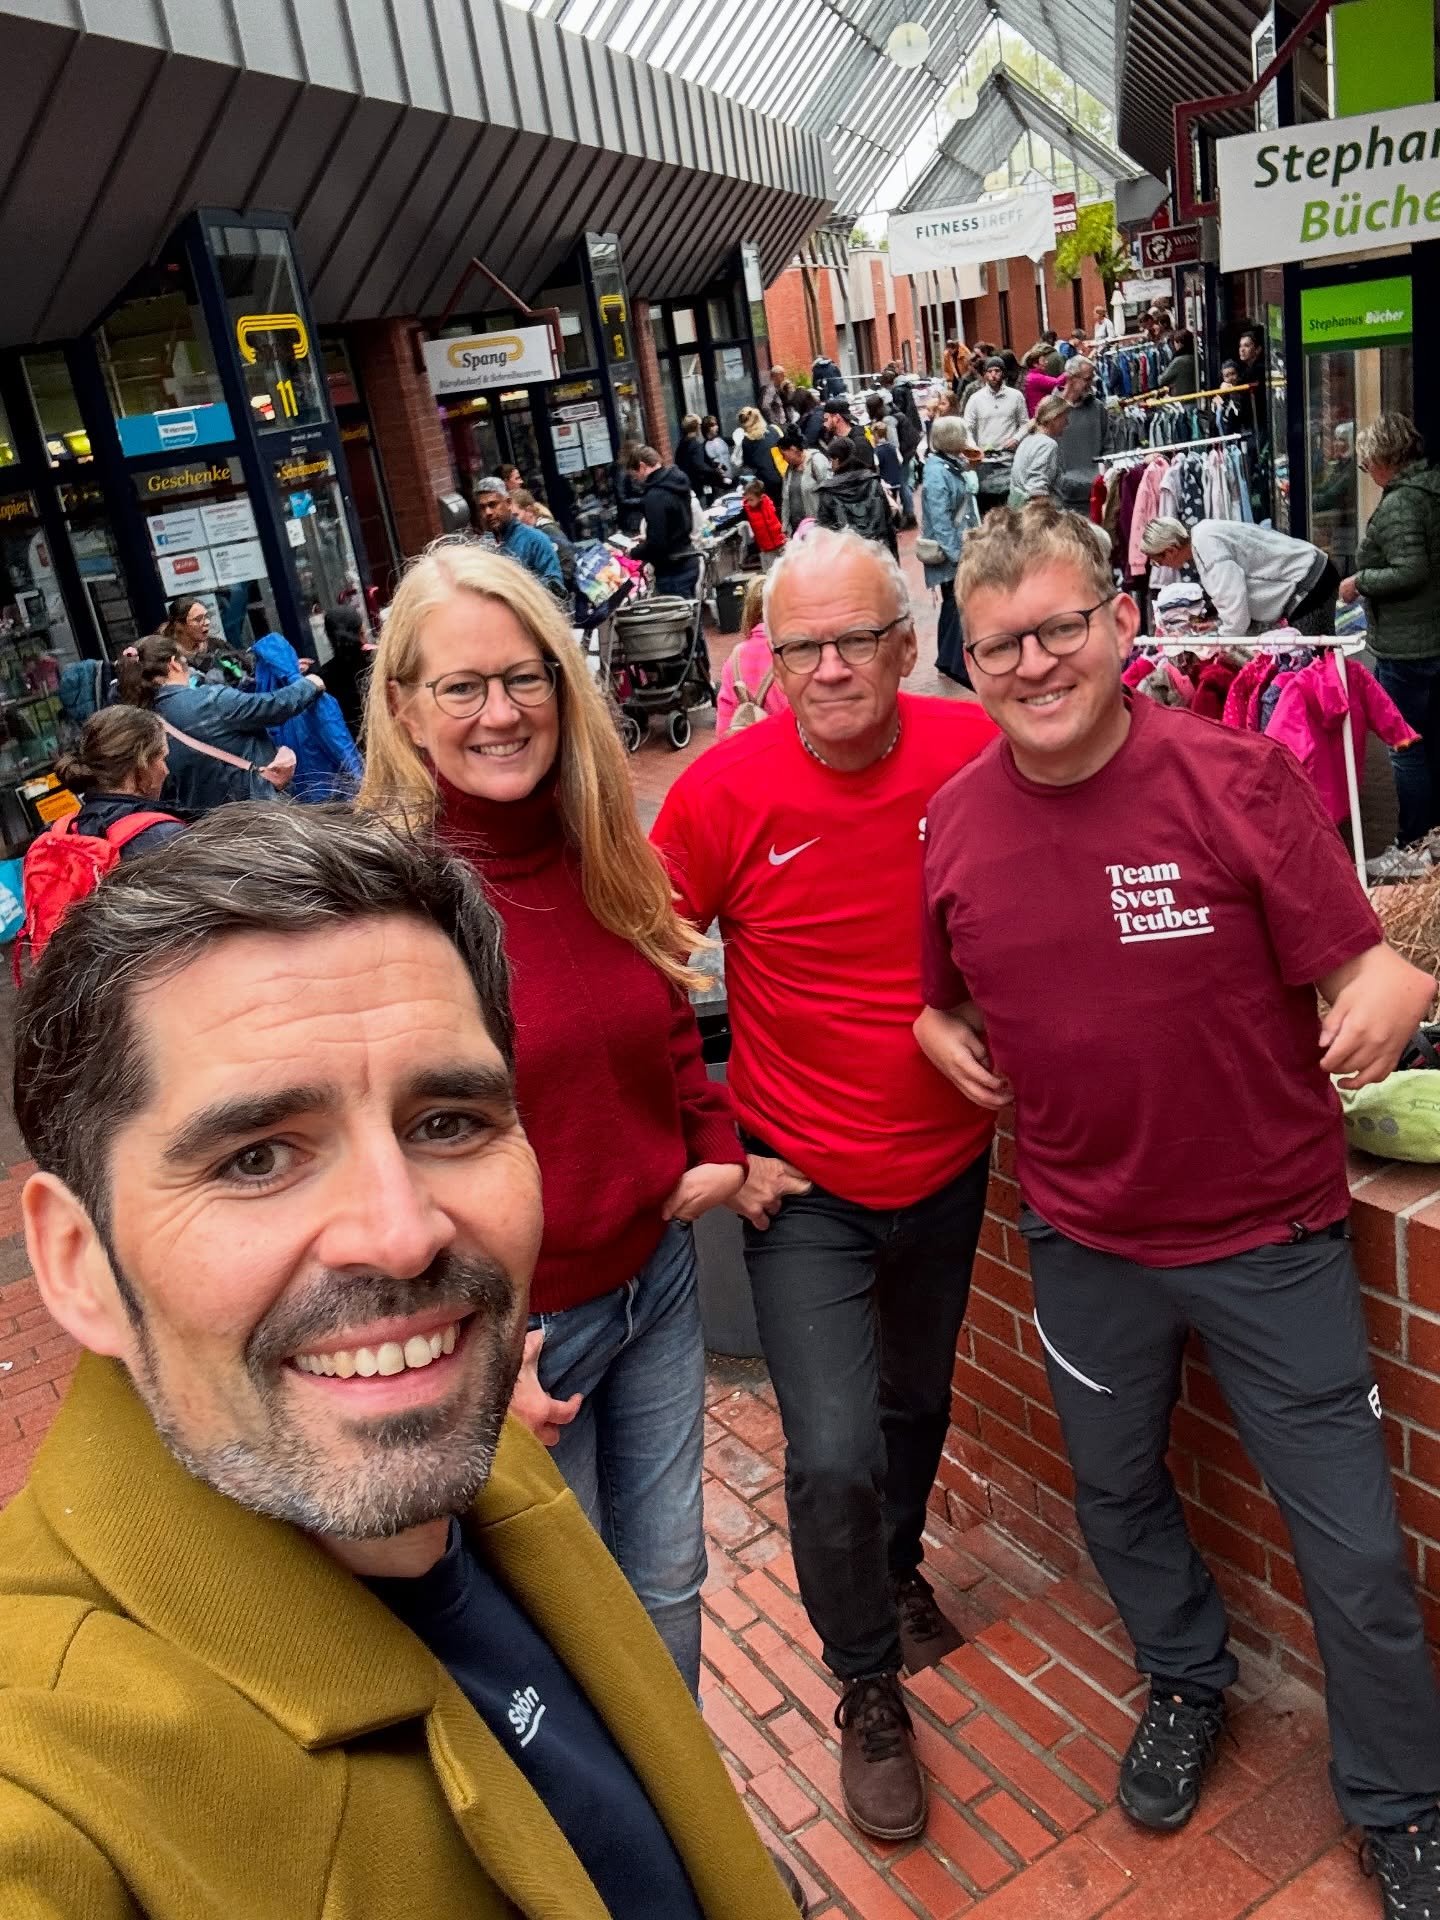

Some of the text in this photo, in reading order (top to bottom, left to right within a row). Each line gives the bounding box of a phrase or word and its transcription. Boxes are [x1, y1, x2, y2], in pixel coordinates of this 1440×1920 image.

[1309, 309, 1404, 331] Stephanus Bücher
[462, 352, 507, 371] Spang
[276, 379, 299, 417] 11
[147, 465, 231, 492] Geschenke
[1105, 862, 1181, 887] Team
[1110, 886, 1176, 911] Sven
[1114, 906, 1211, 934] Teuber
